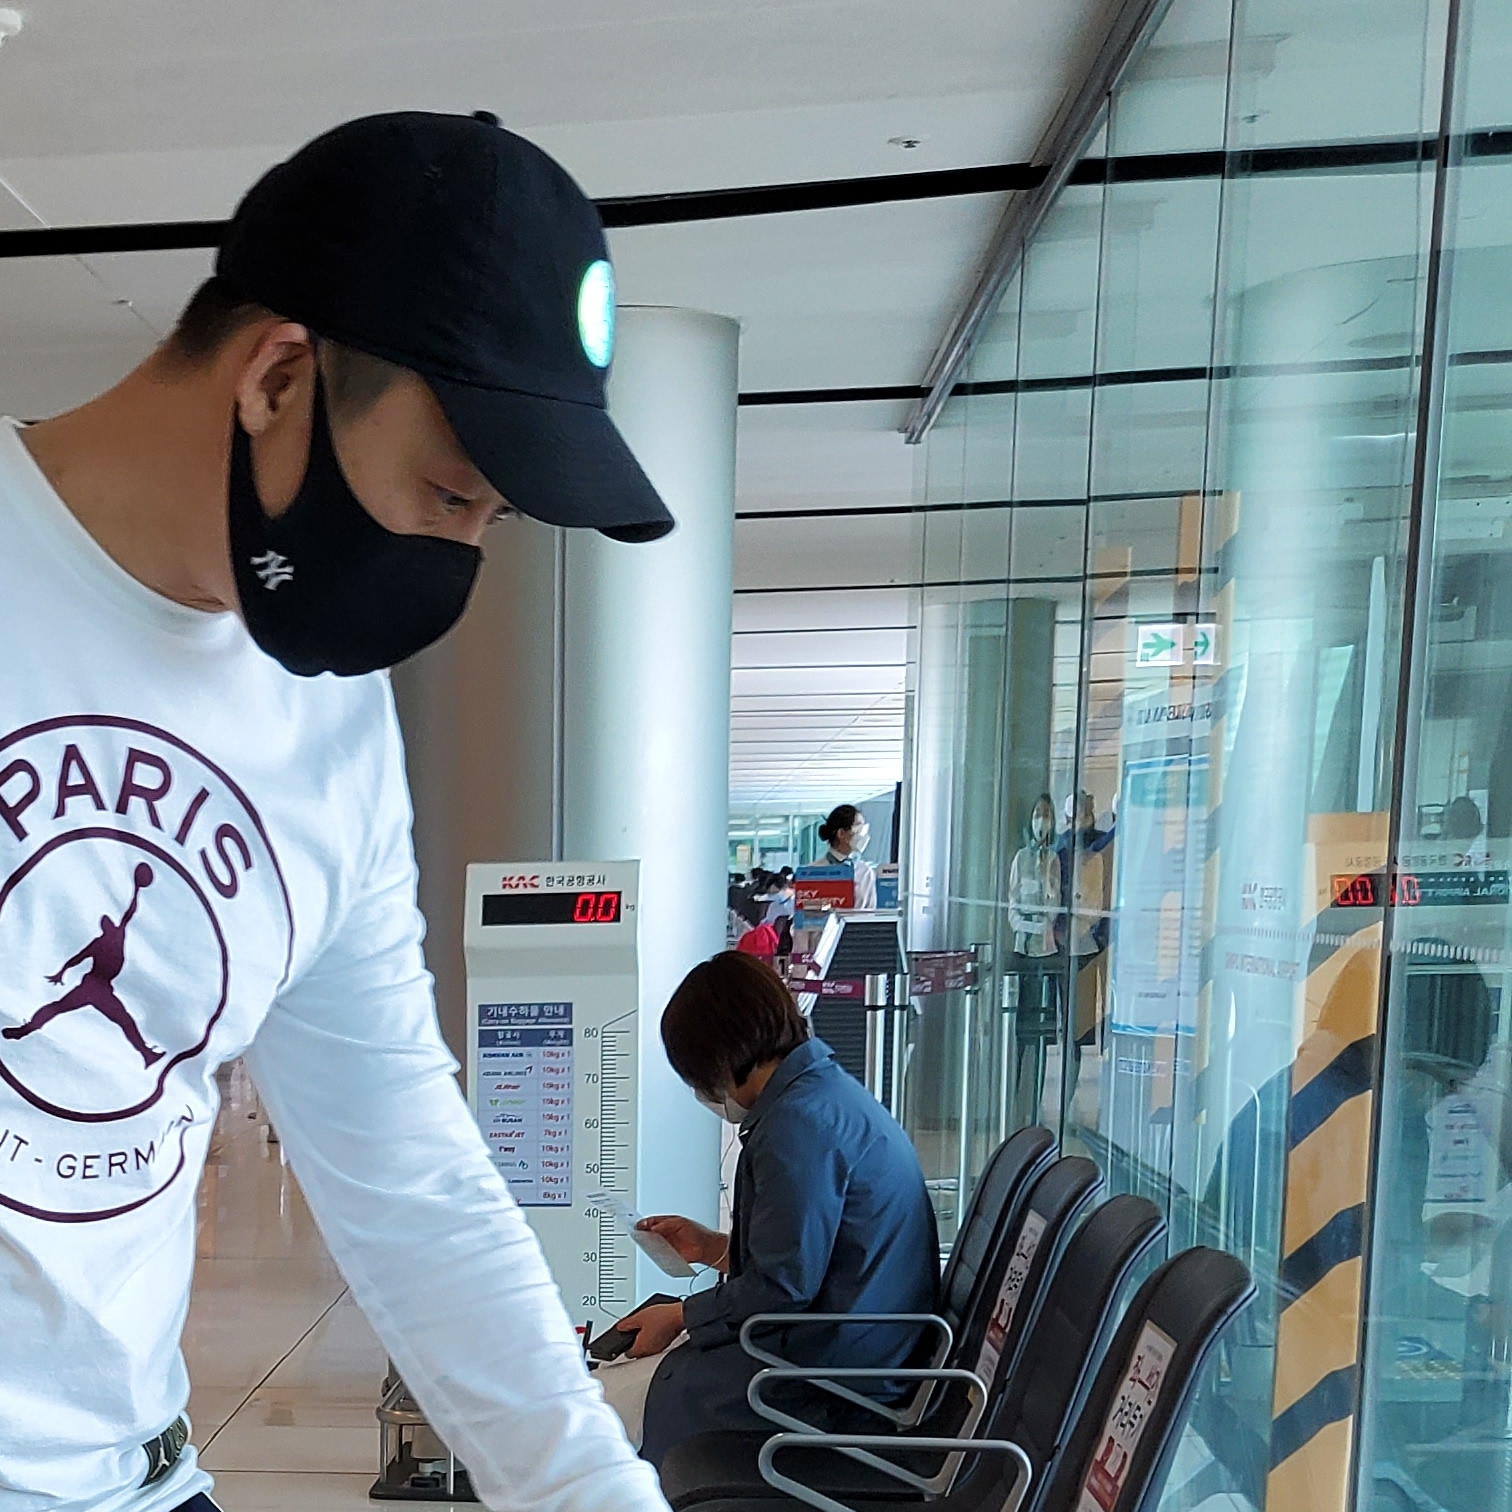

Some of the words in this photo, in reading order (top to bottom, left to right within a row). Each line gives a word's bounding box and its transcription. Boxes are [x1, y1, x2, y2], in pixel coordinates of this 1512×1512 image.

[502, 875, 540, 889] KAC
[584, 1028, 598, 1038] 80
[584, 1074, 598, 1084] 70
[584, 1119, 598, 1128] 60
[585, 1163, 599, 1173] 50
[584, 1208, 598, 1218] 40
[583, 1253, 597, 1262] 30
[582, 1296, 596, 1305] 20
